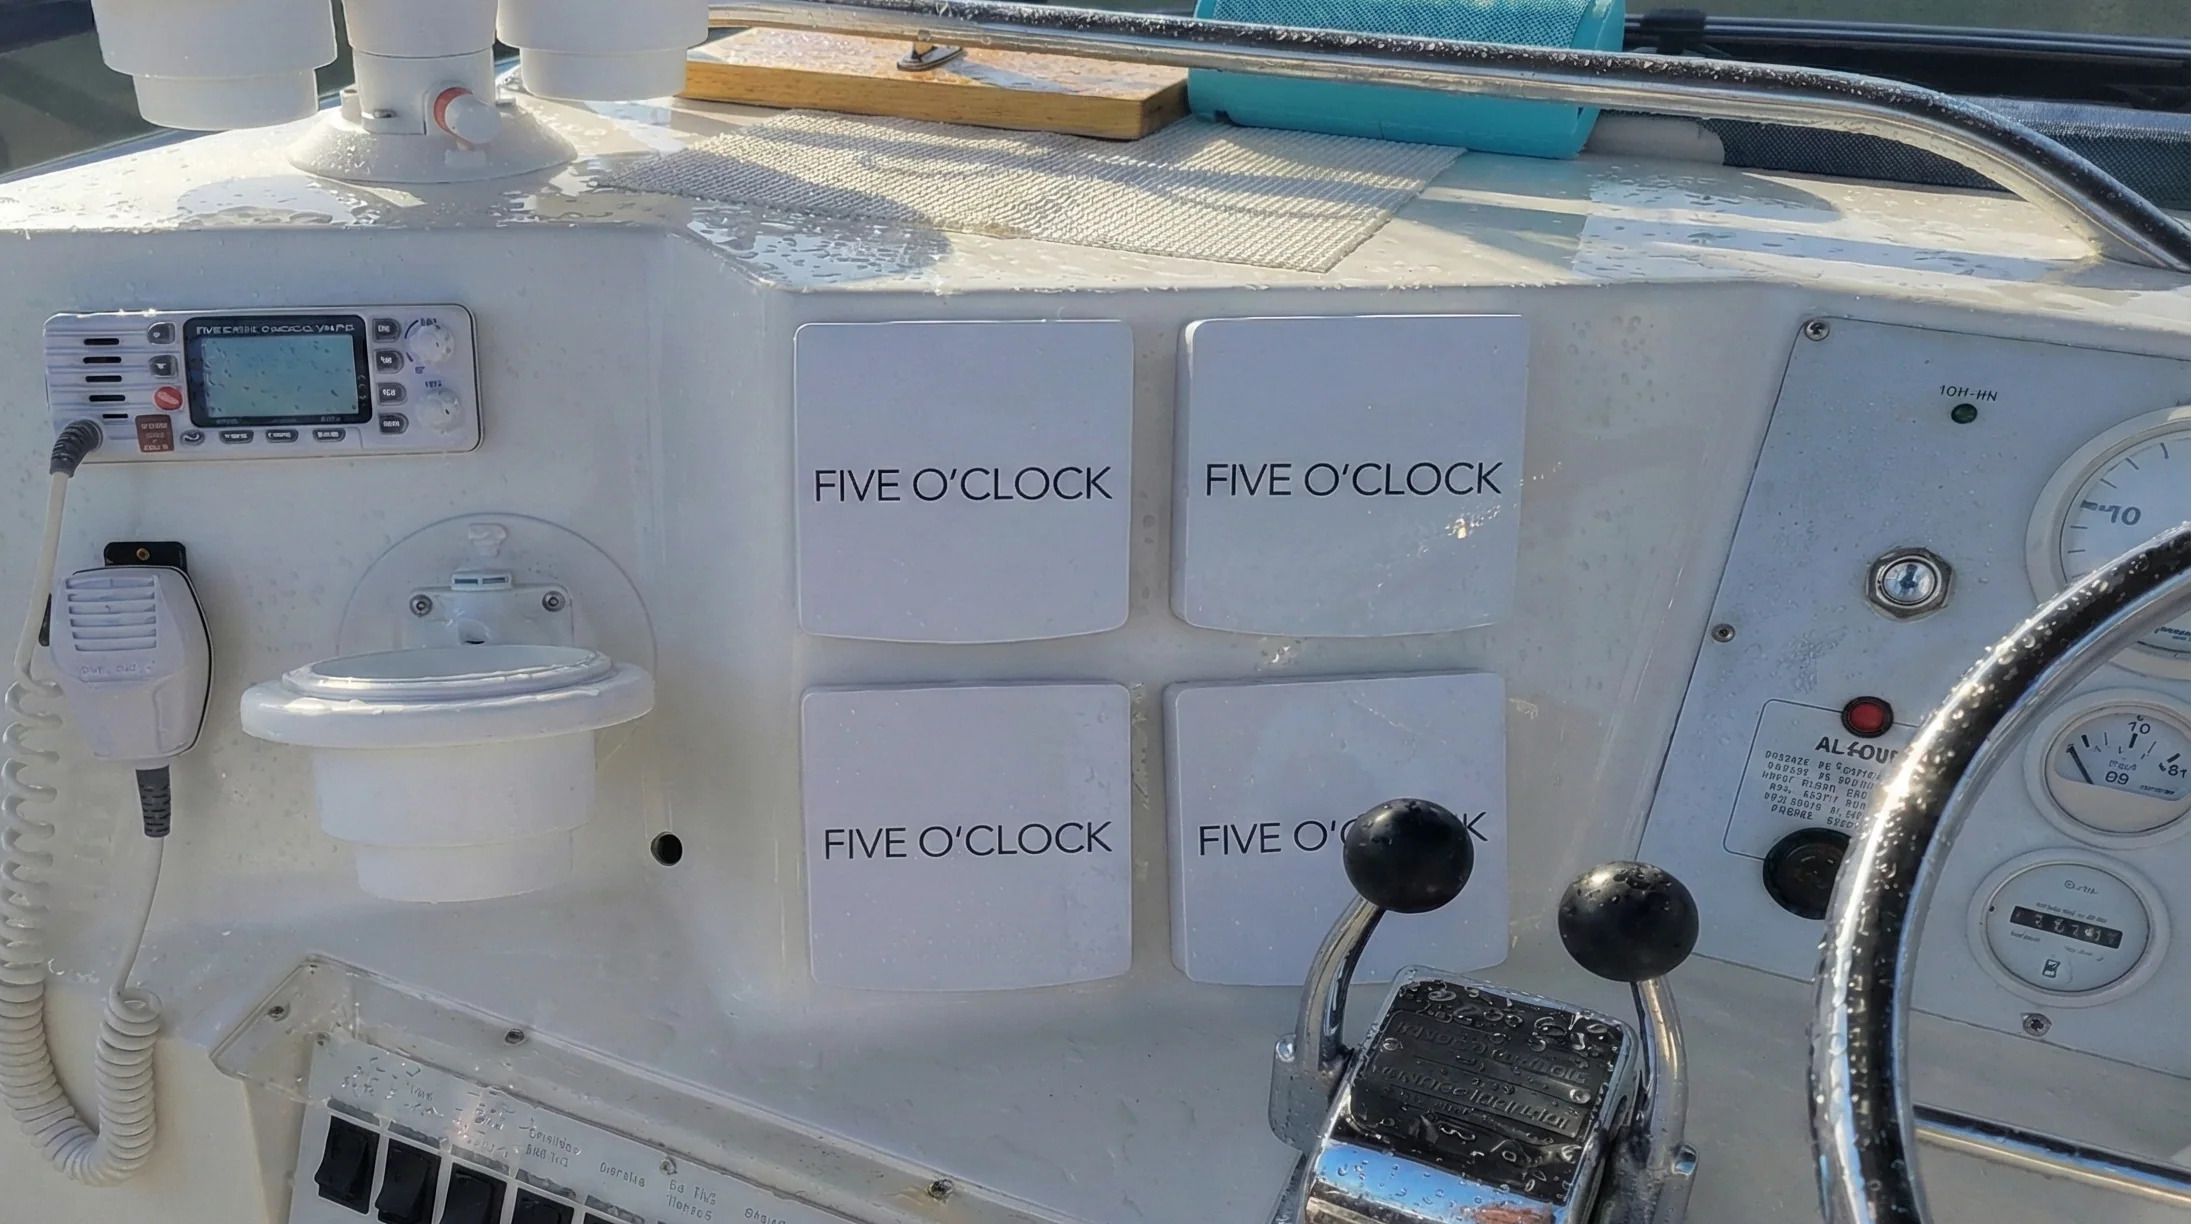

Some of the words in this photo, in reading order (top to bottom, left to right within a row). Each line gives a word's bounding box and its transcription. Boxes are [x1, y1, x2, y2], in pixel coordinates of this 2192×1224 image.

[815, 469, 901, 502] FIVE
[912, 466, 1113, 501] O'CLOCK
[1205, 463, 1292, 496] FIVE
[1304, 461, 1503, 496] O'CLOCK
[825, 827, 908, 860] FIVE
[918, 821, 1113, 857] O'CLOCK
[1198, 822, 1282, 856] FIVE
